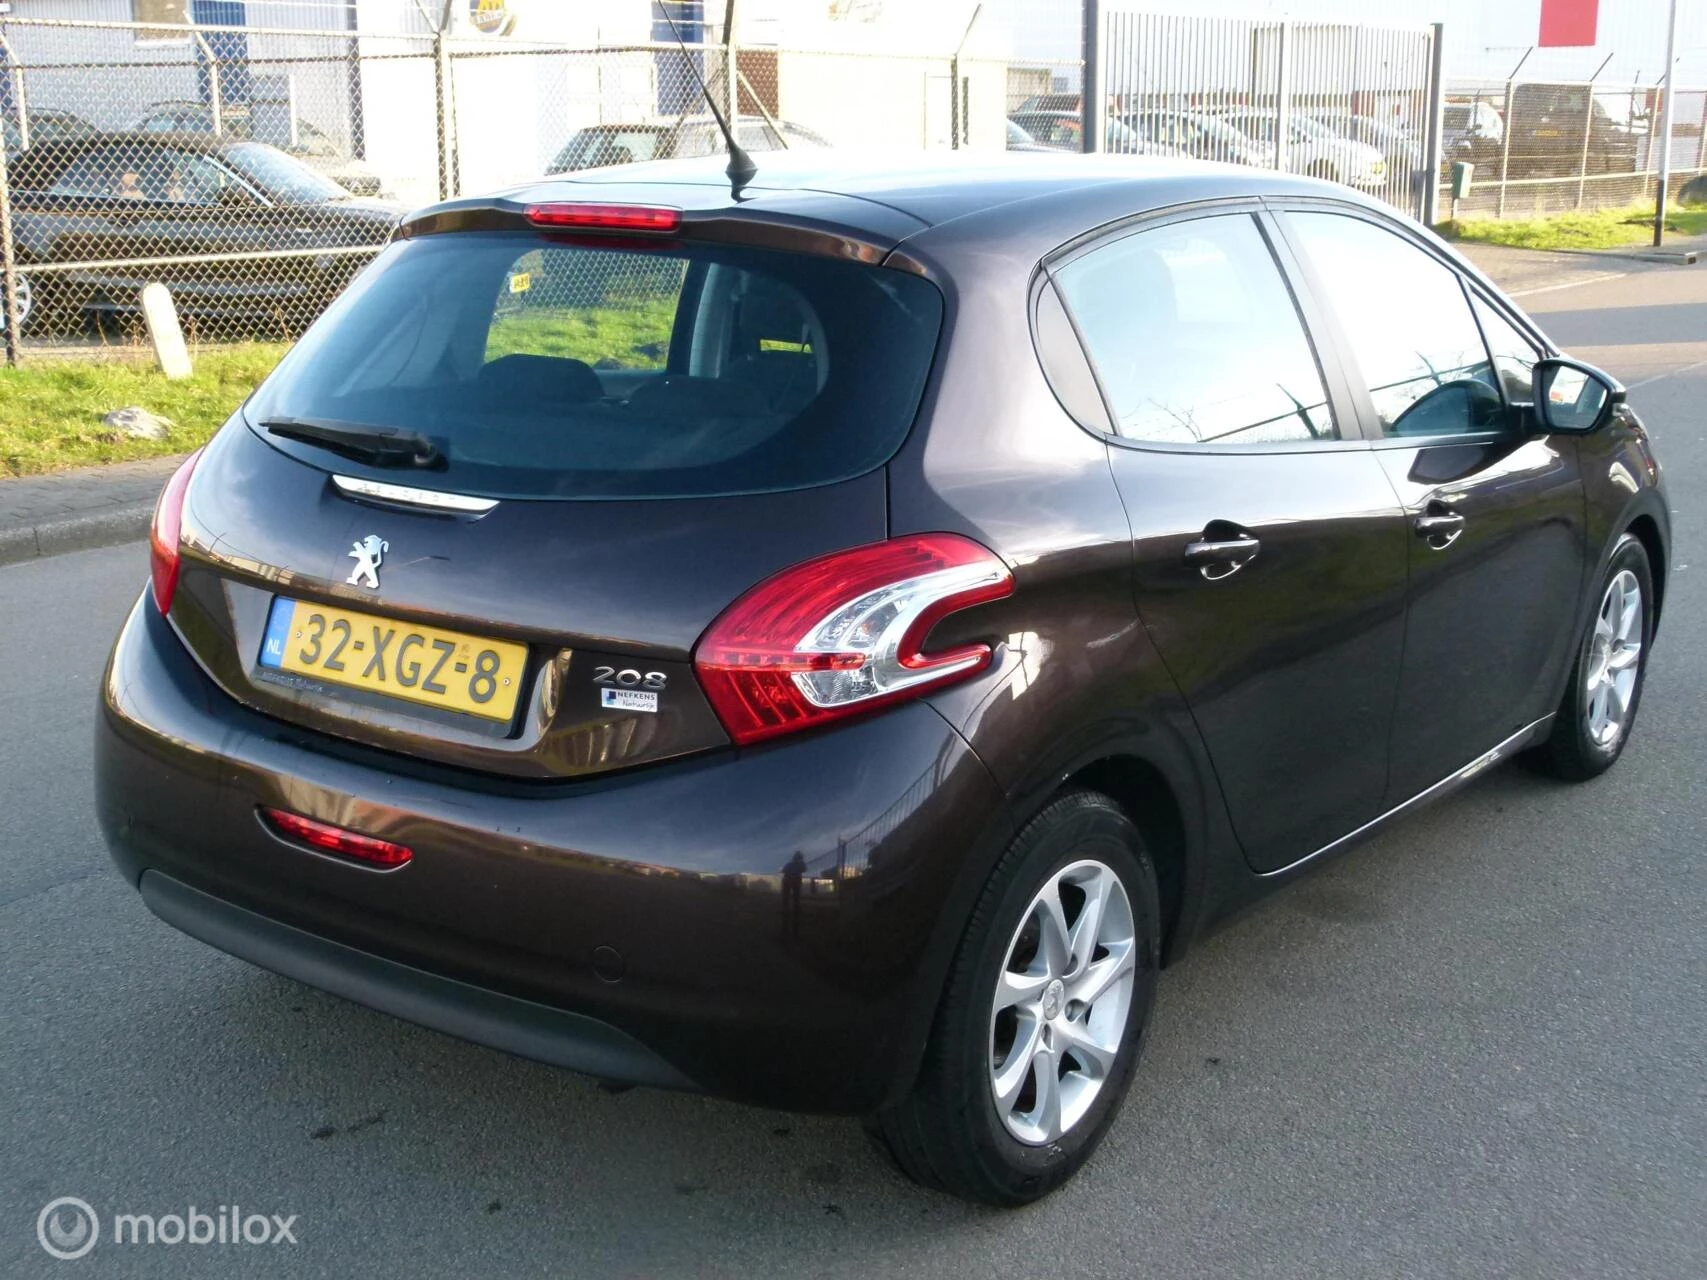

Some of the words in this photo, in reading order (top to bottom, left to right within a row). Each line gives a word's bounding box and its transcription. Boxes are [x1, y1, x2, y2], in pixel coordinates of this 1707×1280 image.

[266, 637, 281, 655] NL
[299, 613, 501, 703] 32-XGZ-8
[593, 666, 667, 690] 208
[617, 692, 655, 700] NEFKENS
